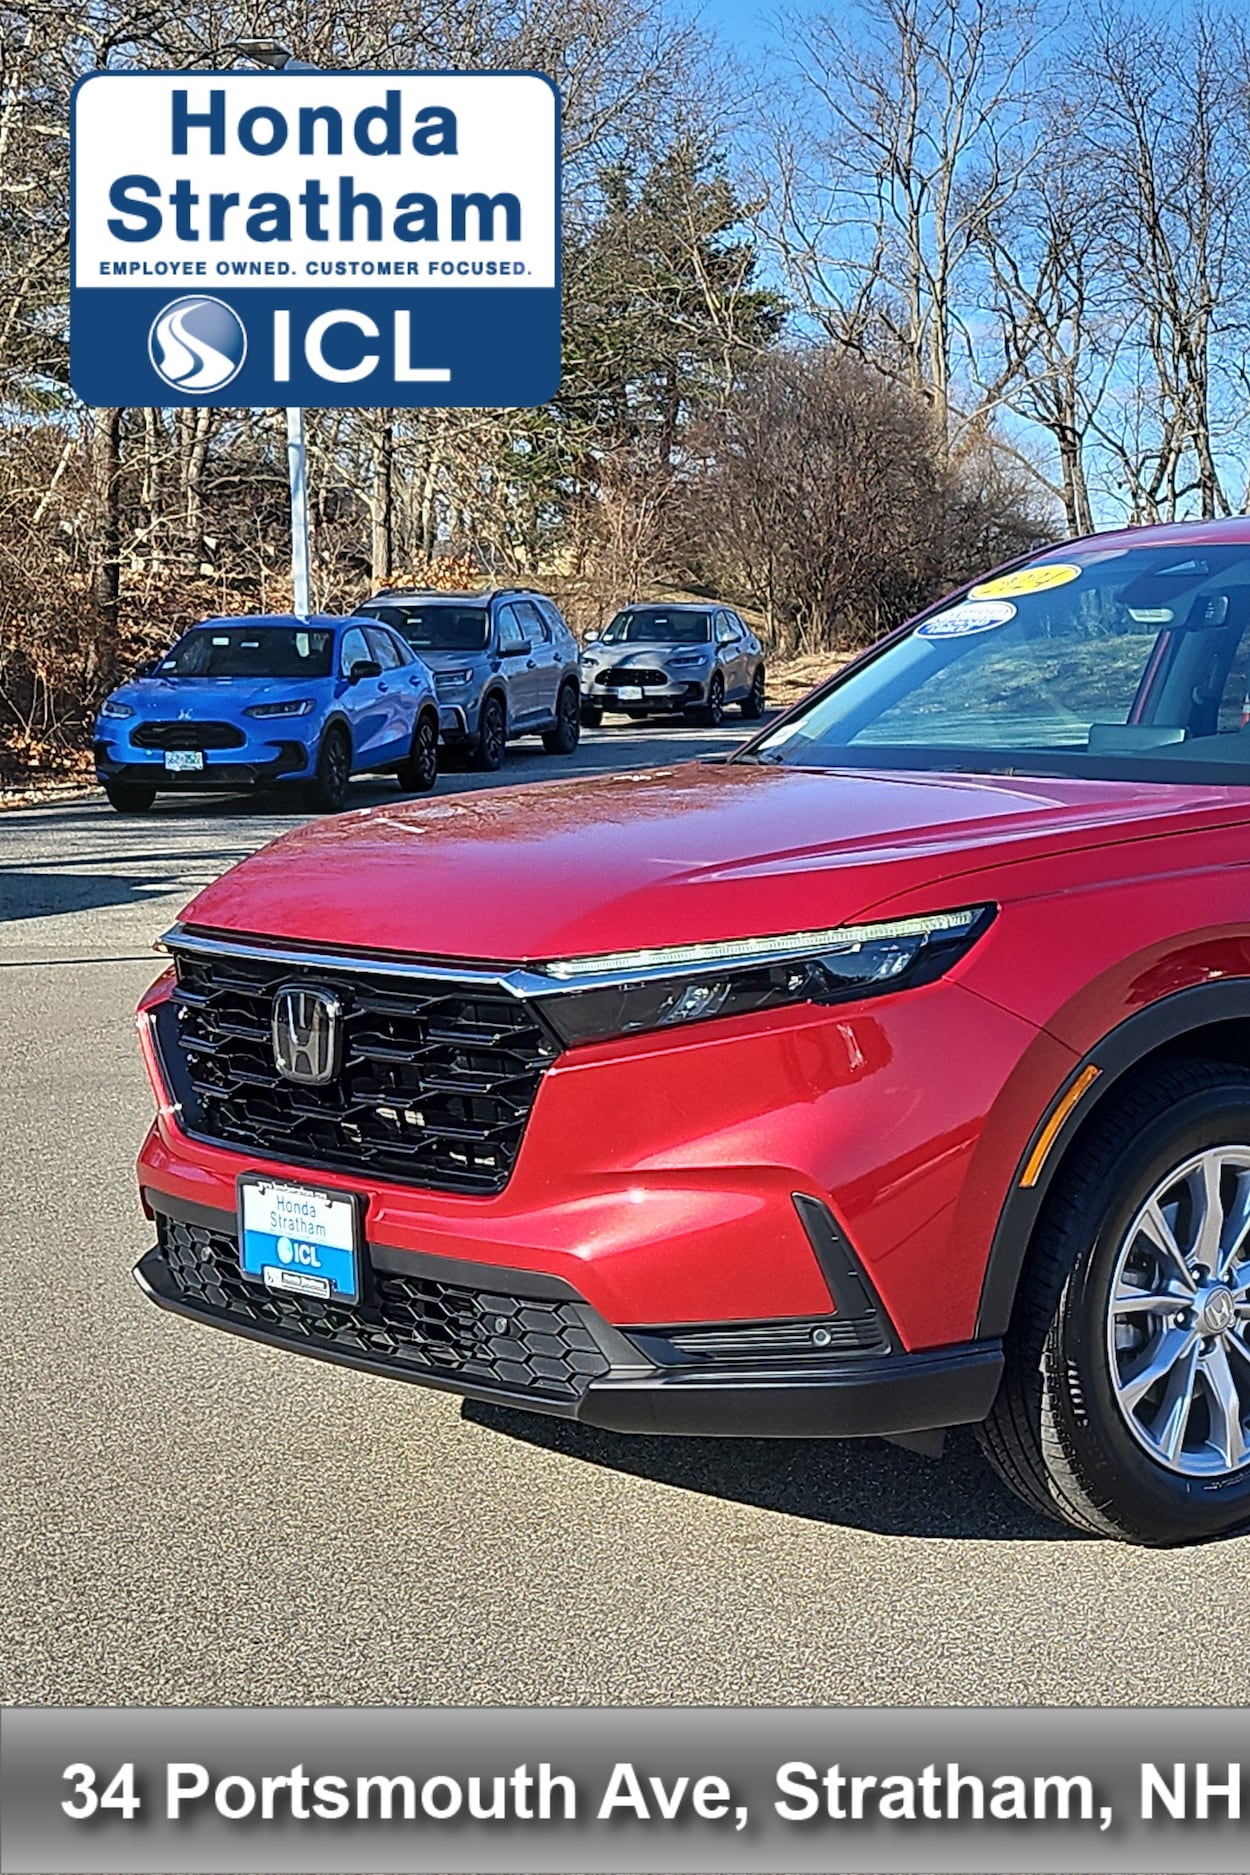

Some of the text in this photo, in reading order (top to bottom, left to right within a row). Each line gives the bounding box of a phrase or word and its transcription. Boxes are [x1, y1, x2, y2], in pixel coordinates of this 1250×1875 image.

[276, 1195, 317, 1218] Honda
[270, 1211, 327, 1238] Stratham
[293, 1242, 322, 1268] ICL
